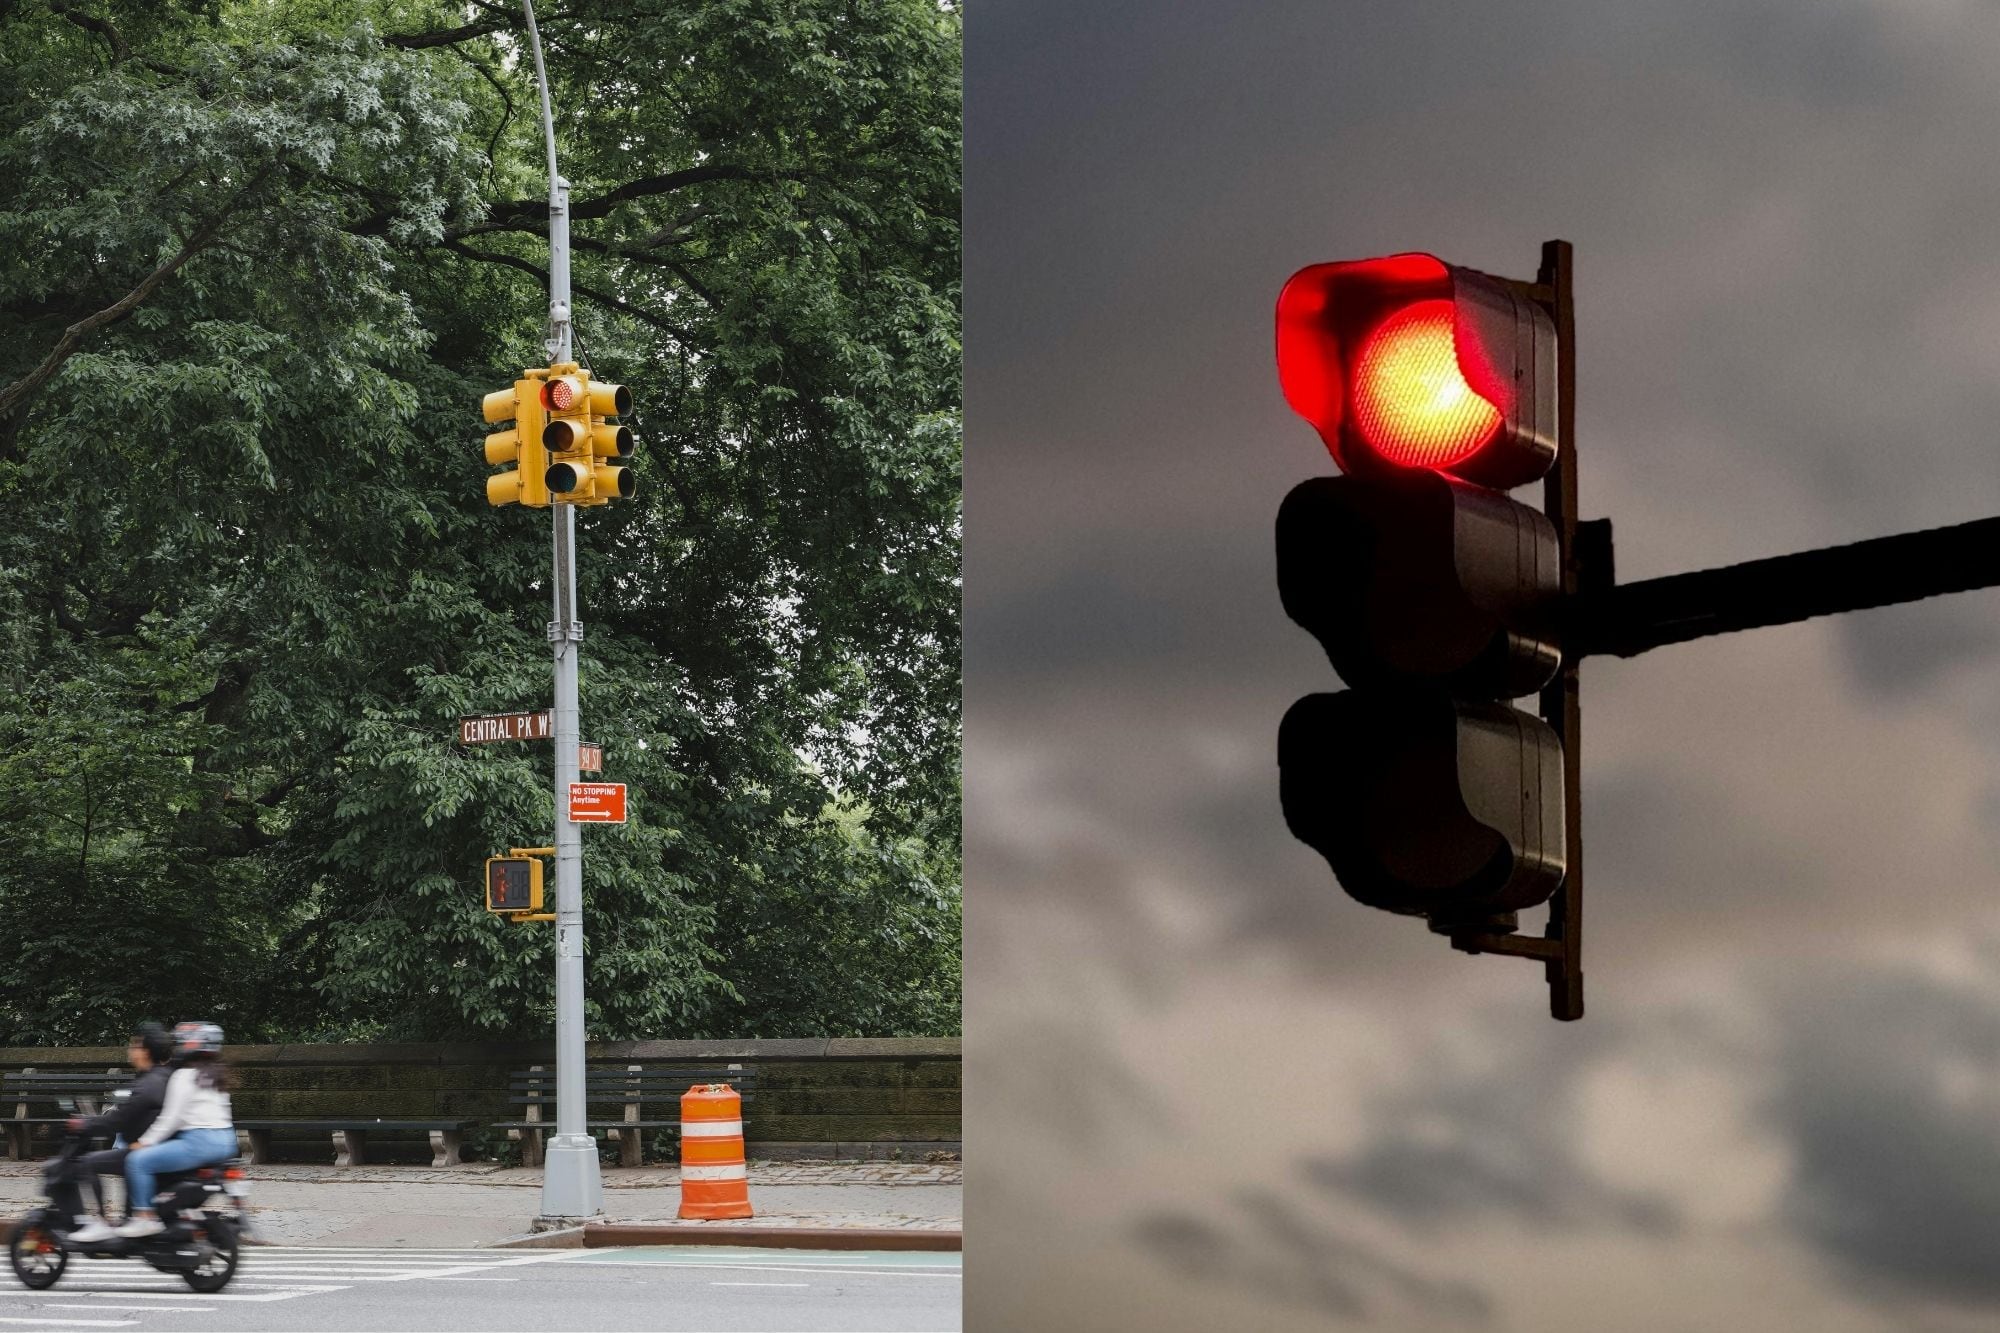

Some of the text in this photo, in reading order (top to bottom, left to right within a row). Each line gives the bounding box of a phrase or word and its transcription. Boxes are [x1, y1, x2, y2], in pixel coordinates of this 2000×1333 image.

[464, 715, 548, 741] CENTRAL PK W
[592, 749, 600, 770] ST
[583, 788, 616, 796] STOPPING
[572, 796, 601, 805] Anytime
